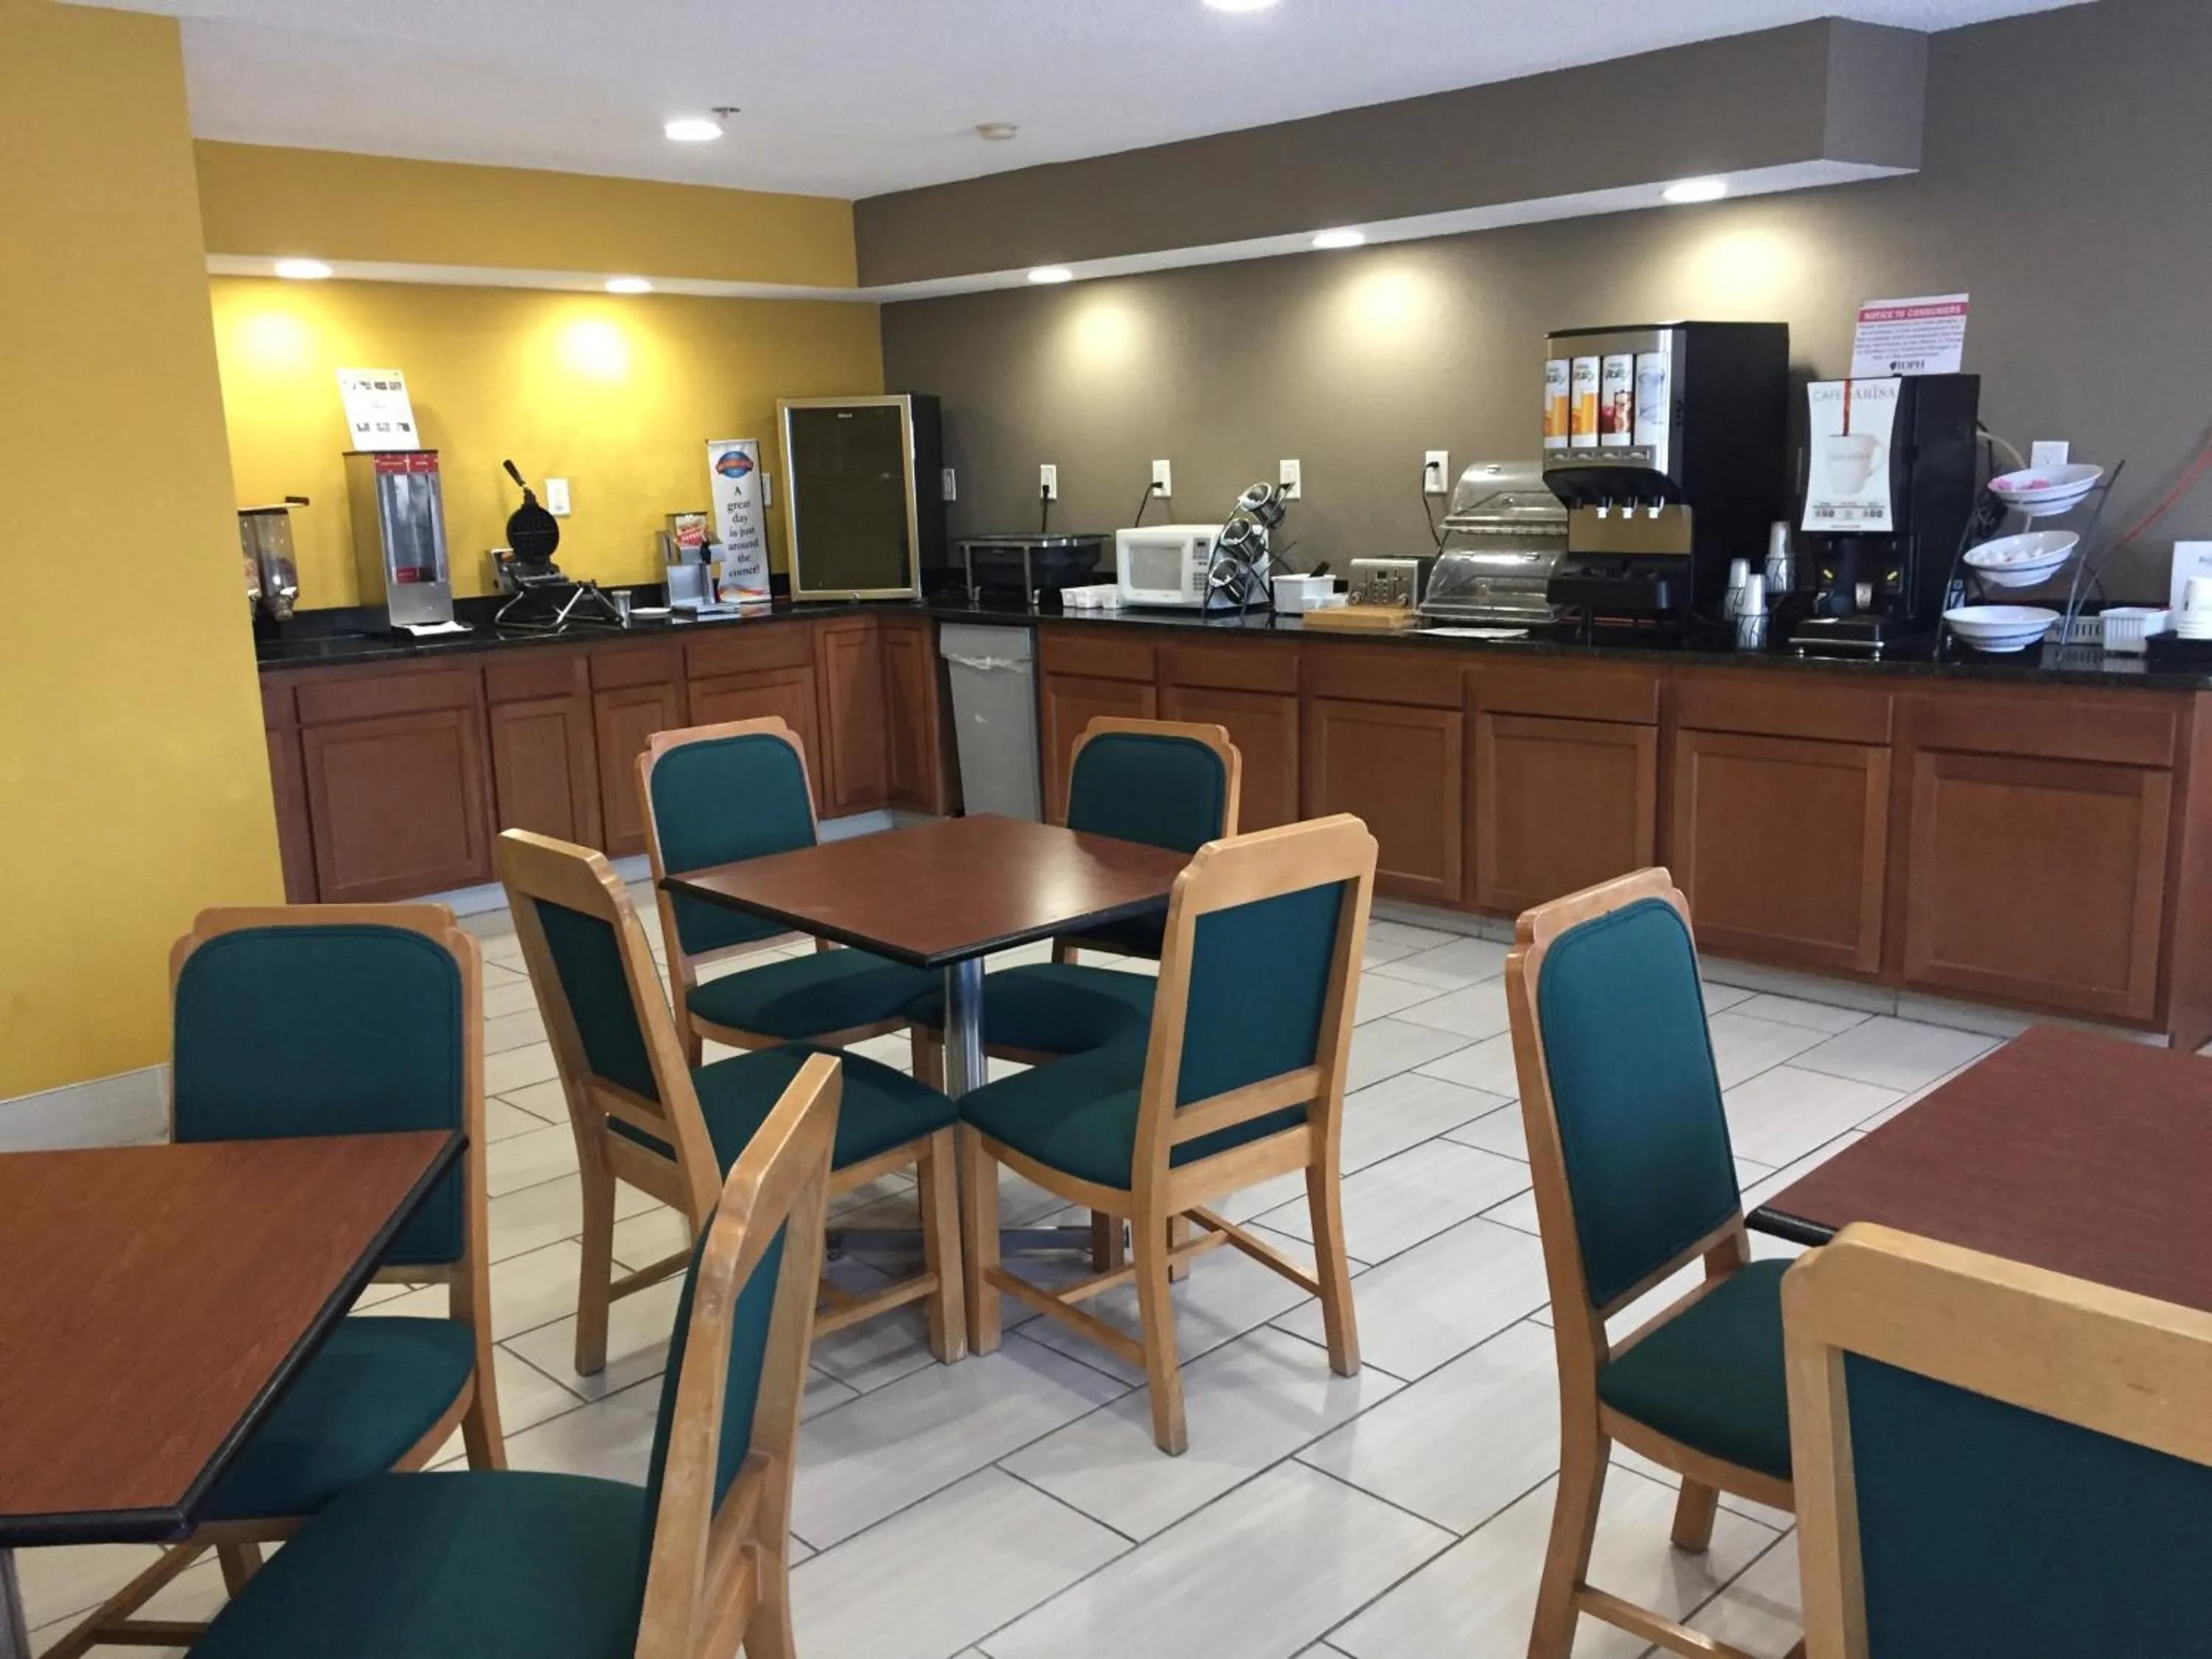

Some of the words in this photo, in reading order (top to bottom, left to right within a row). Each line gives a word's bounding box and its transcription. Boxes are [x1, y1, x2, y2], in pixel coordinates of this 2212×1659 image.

[734, 486, 742, 495] A
[727, 500, 751, 512] great
[732, 513, 748, 524] day
[729, 528, 738, 537] is
[739, 527, 756, 539] just
[728, 540, 759, 551] around
[737, 553, 751, 563] the
[728, 566, 761, 578] corner!
